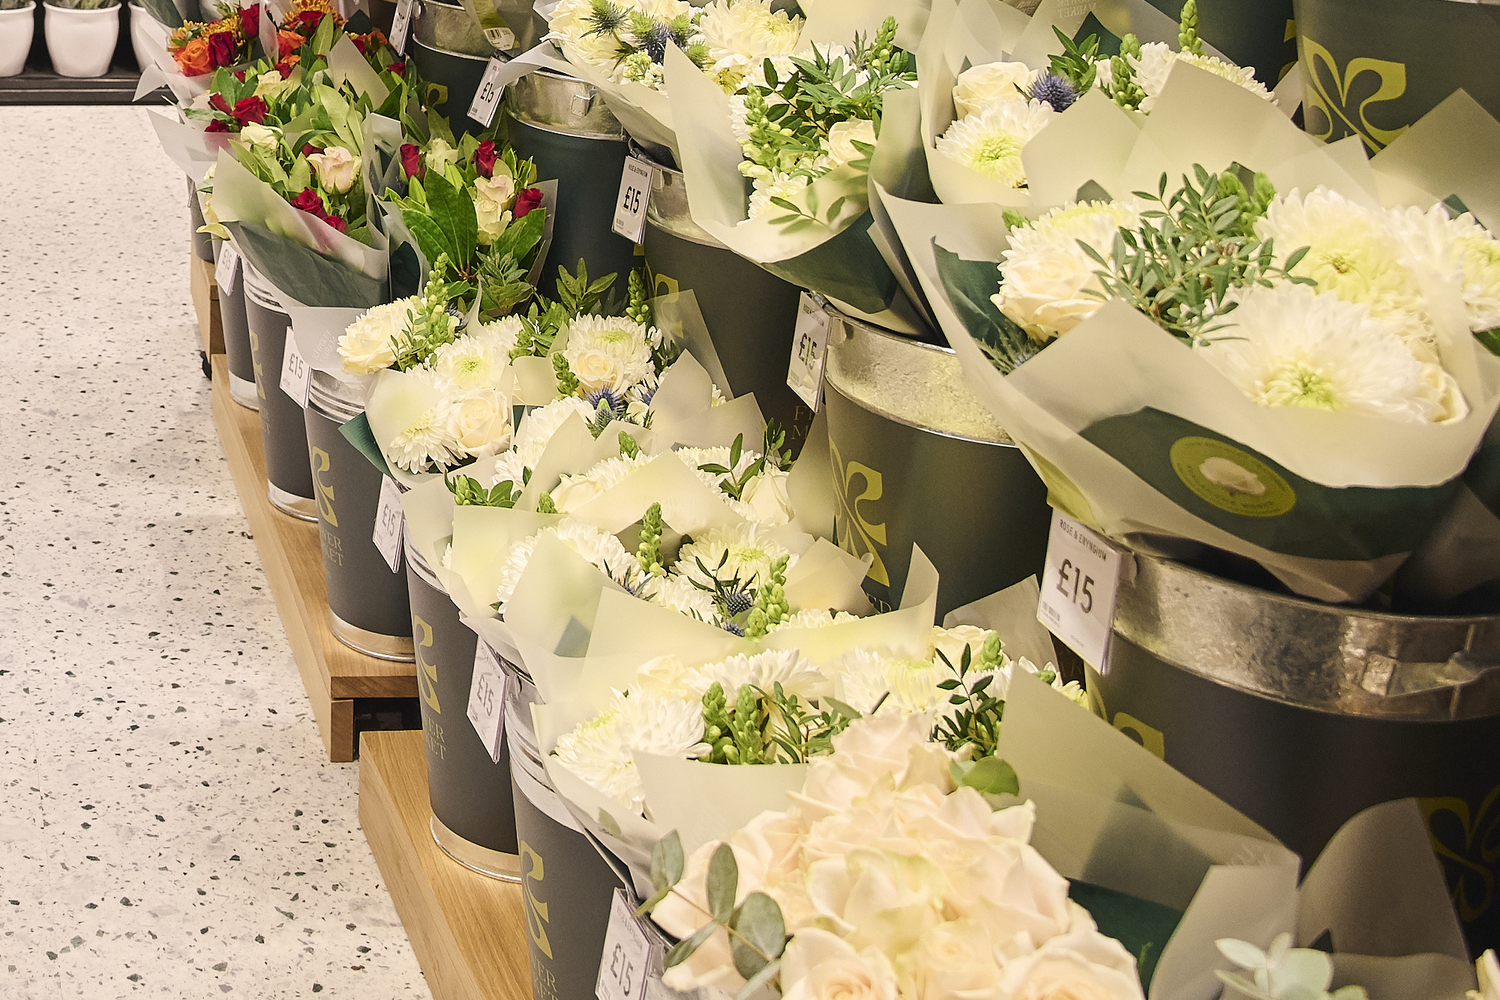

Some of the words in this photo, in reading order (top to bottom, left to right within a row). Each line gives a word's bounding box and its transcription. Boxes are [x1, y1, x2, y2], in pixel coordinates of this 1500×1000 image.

[623, 186, 642, 214] £15
[288, 353, 304, 379] £15
[798, 332, 817, 370] £15
[382, 503, 396, 538] £15
[1059, 518, 1073, 537] ROSE
[1078, 533, 1107, 562] ERYNGIUM
[1056, 558, 1095, 614] £15
[478, 673, 493, 717] £15
[610, 942, 633, 997] £15
